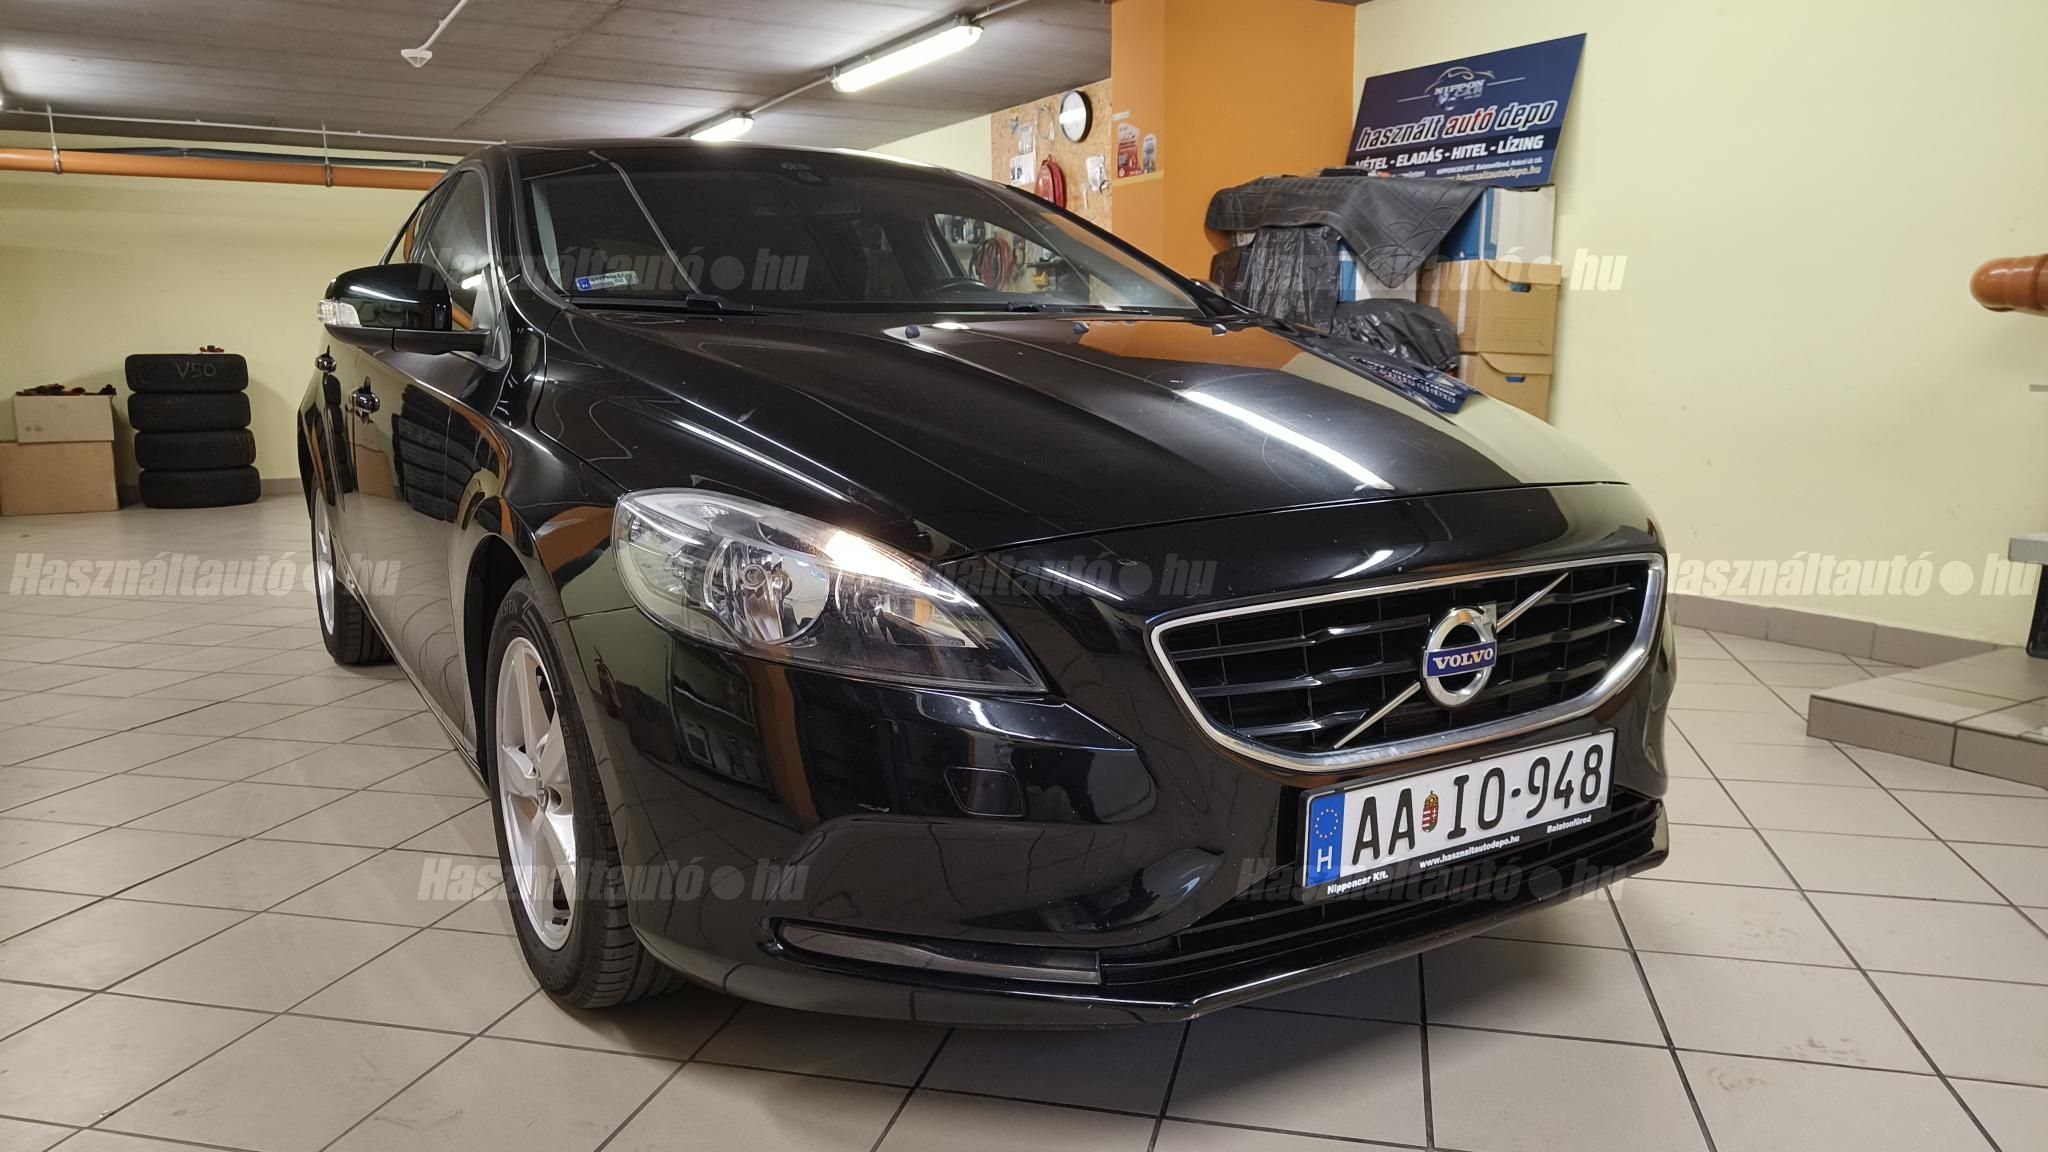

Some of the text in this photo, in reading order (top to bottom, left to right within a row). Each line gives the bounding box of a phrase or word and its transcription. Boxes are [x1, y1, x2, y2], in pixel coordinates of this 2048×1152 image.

[1356, 100, 1558, 151] használt autó depo
[1395, 146, 1444, 167] ELADÁS
[1451, 143, 1488, 160] HITEL
[1497, 134, 1544, 154] LÍZING
[175, 360, 217, 379] V50
[1433, 648, 1493, 670] VOLVO
[1352, 787, 1416, 866] AA
[1316, 846, 1333, 873] H
[1327, 814, 1592, 895] Nipponcar Kft. www.hasznaltautodepo.hu Balatonfüred
